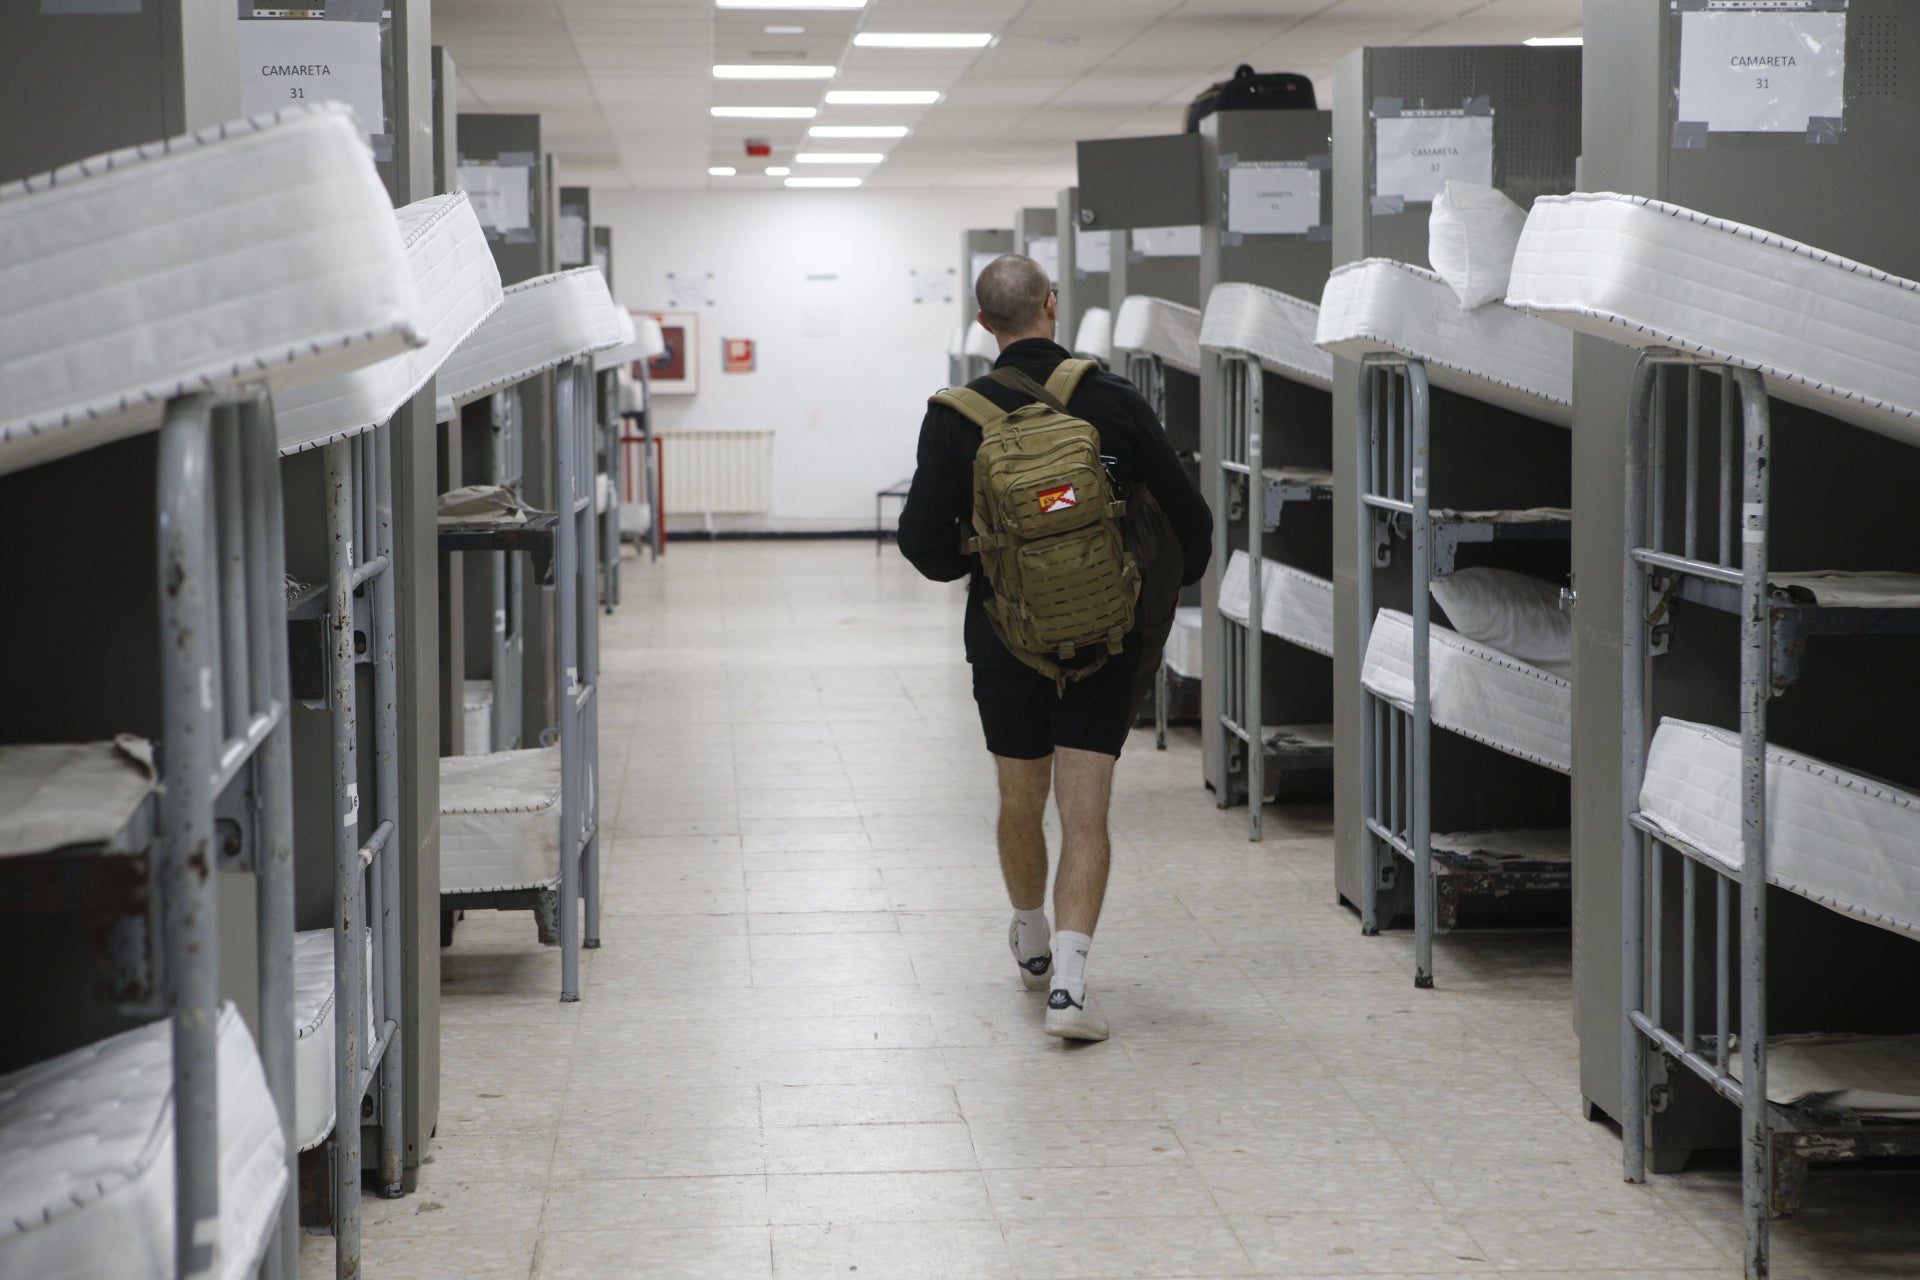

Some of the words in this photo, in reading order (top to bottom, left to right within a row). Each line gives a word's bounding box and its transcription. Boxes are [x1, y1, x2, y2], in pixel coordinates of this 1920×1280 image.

[1730, 56, 1796, 67] CAMARETA
[261, 64, 331, 76] CAMARETA
[1756, 78, 1769, 89] 31
[289, 87, 305, 99] 31
